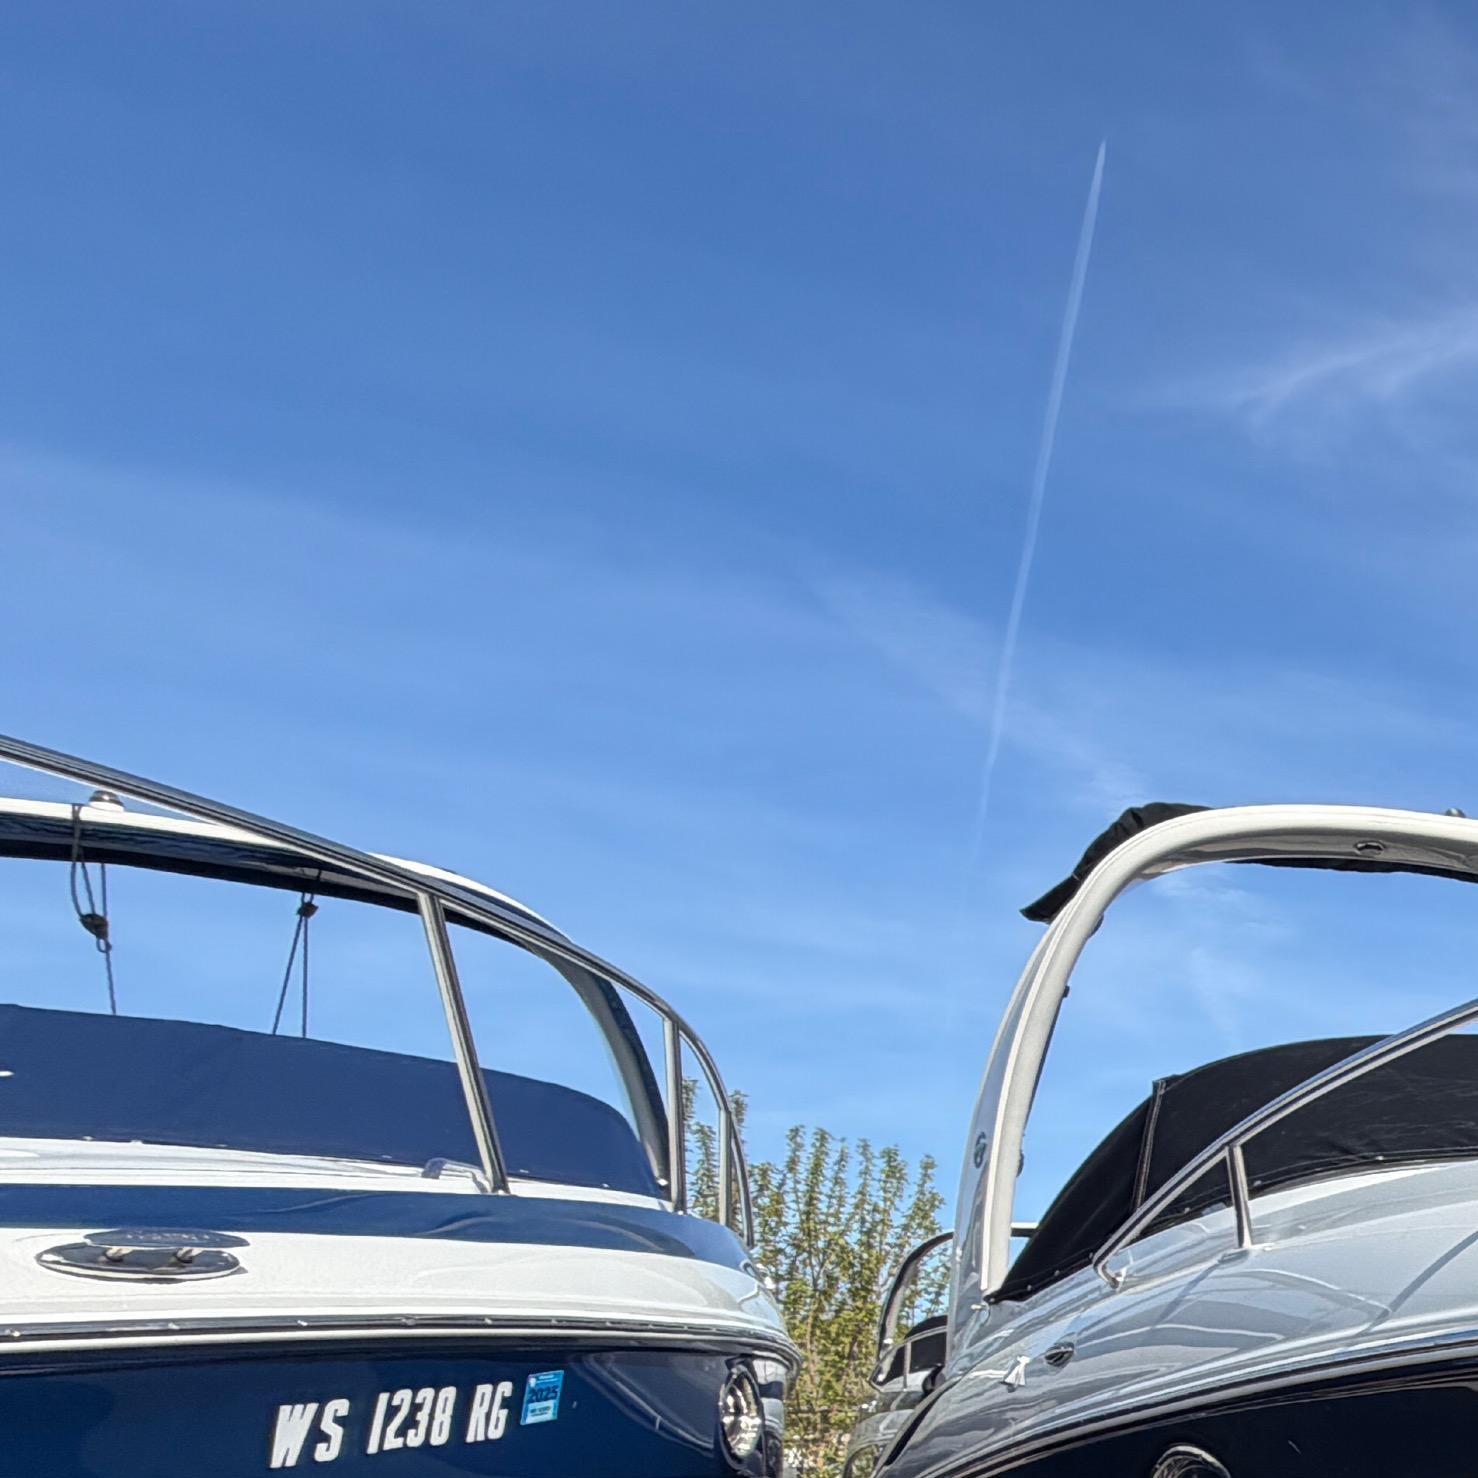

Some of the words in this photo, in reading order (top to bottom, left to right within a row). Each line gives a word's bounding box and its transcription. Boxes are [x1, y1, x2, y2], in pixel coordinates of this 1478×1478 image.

[526, 1384, 560, 1404] 2025
[270, 1398, 350, 1469] WS
[366, 1386, 457, 1455] 1238
[465, 1381, 513, 1443] RG
